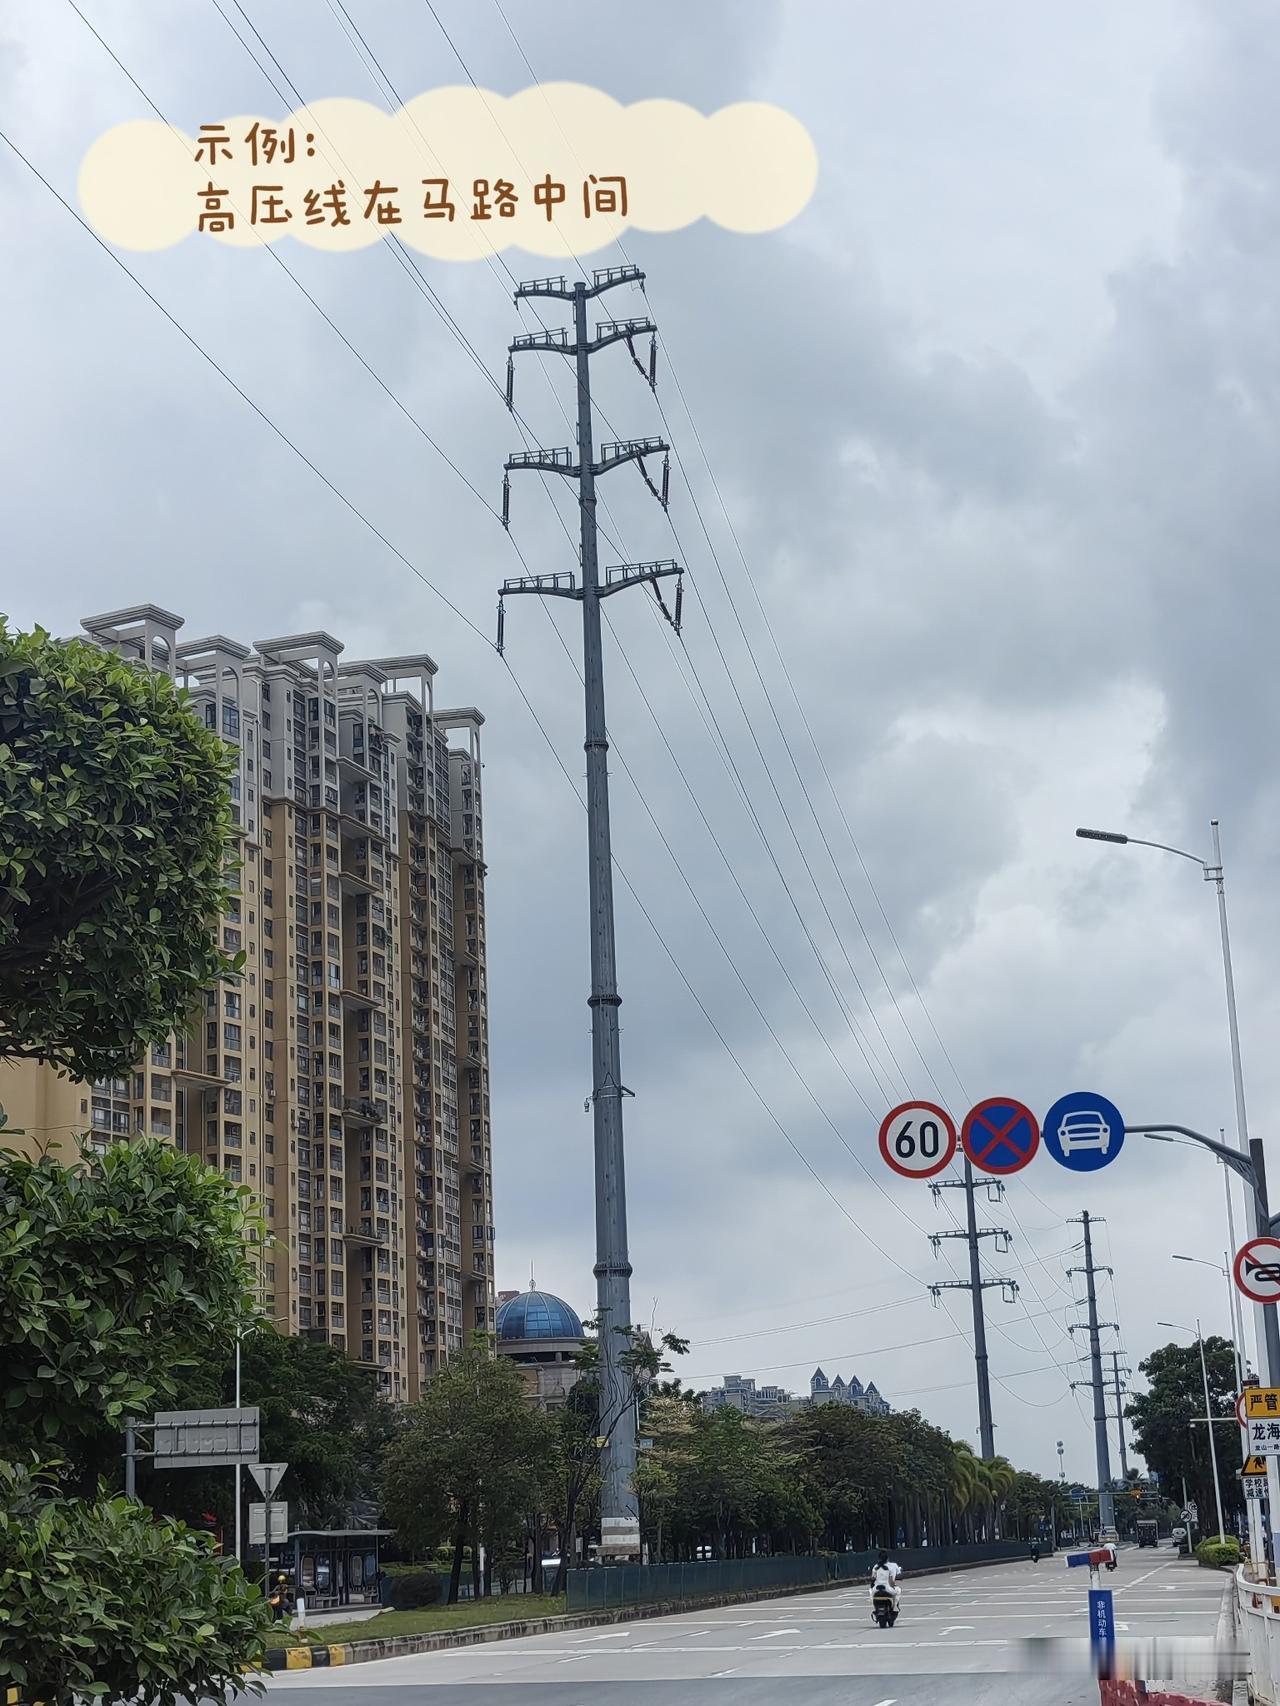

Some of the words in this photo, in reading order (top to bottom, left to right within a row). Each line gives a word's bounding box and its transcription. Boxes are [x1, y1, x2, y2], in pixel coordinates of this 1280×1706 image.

[895, 1120, 939, 1159] 60
[1250, 1393, 1278, 1411] 严管
[1252, 1422, 1280, 1441] 龙海
